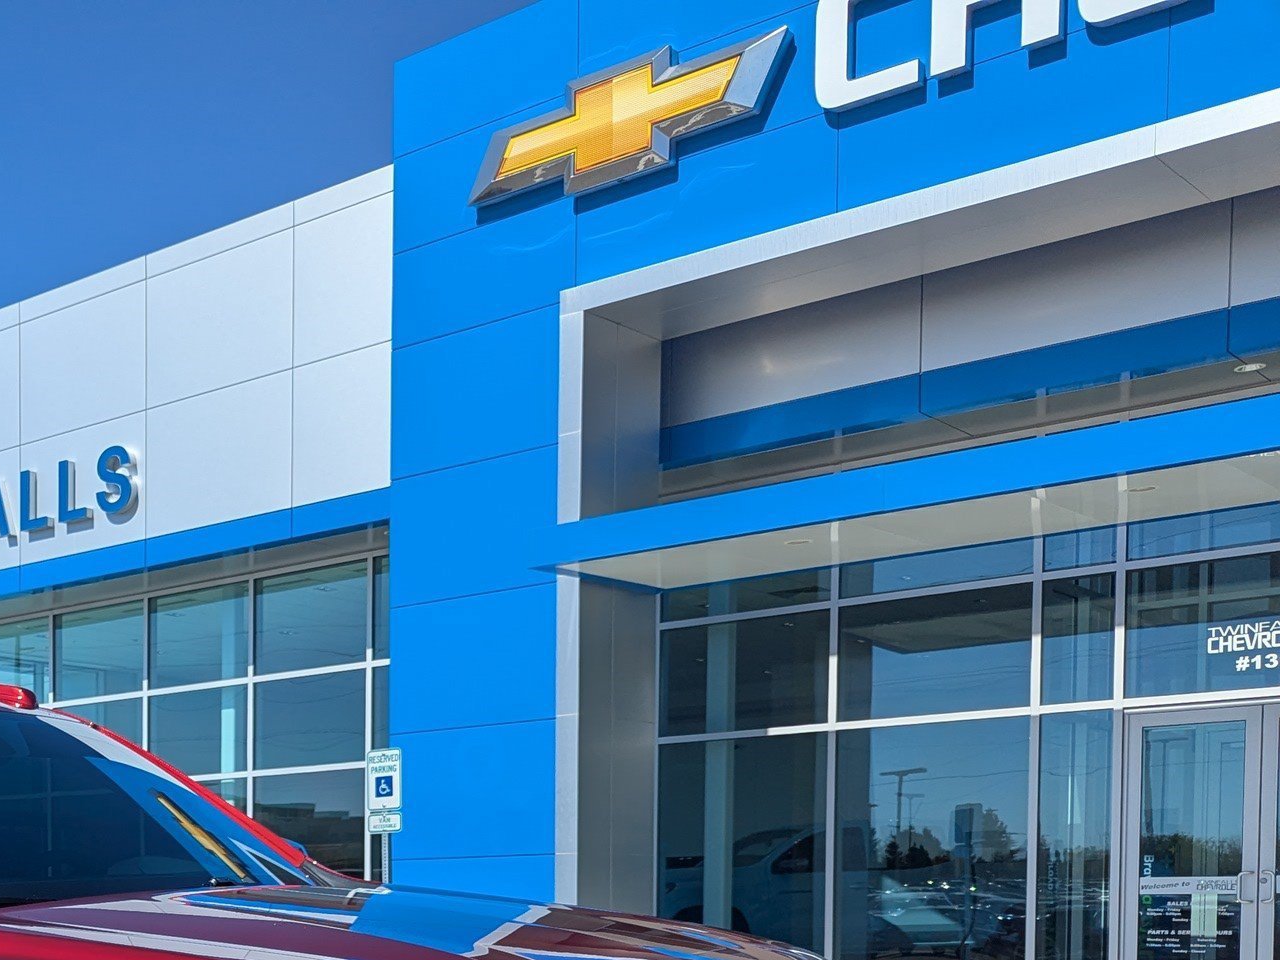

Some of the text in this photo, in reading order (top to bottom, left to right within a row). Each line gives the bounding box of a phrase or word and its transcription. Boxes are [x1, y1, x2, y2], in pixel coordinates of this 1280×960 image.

[368, 753, 399, 764] RESERVED
[370, 764, 397, 774] PARKING
[1141, 882, 1179, 890] Welcome
